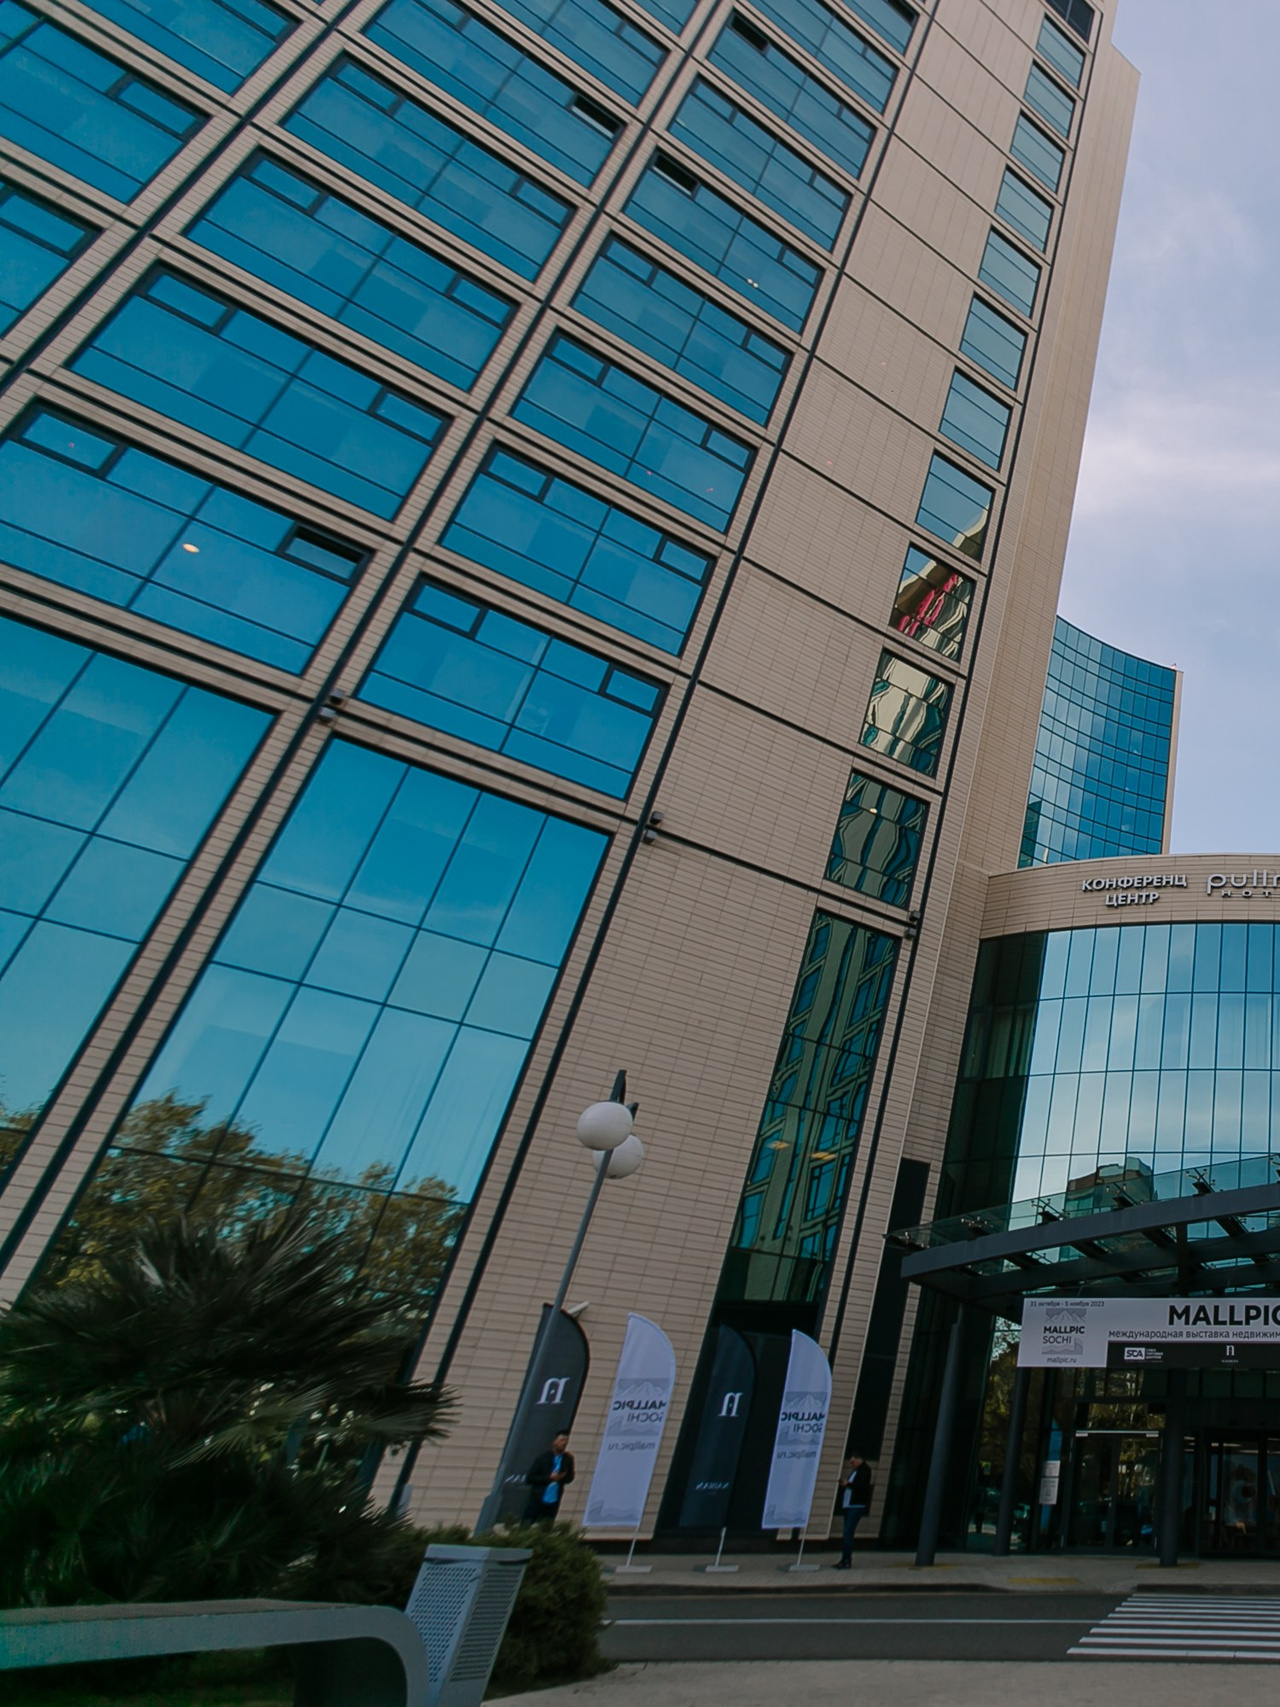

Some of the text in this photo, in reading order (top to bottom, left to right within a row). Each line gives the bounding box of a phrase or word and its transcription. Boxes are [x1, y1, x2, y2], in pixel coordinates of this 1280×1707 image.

[1081, 873, 1187, 891] КОНФЕРЕНЦ
[1105, 891, 1160, 907] ЦЕНТР
[1043, 1326, 1085, 1334] MALLPIC
[1042, 1335, 1072, 1344] SOCHI
[1108, 1330, 1183, 1340] международная
[1186, 1330, 1230, 1339] выставка
[1126, 1349, 1143, 1358] SCA
[1046, 1356, 1077, 1364] mallpic.ru
